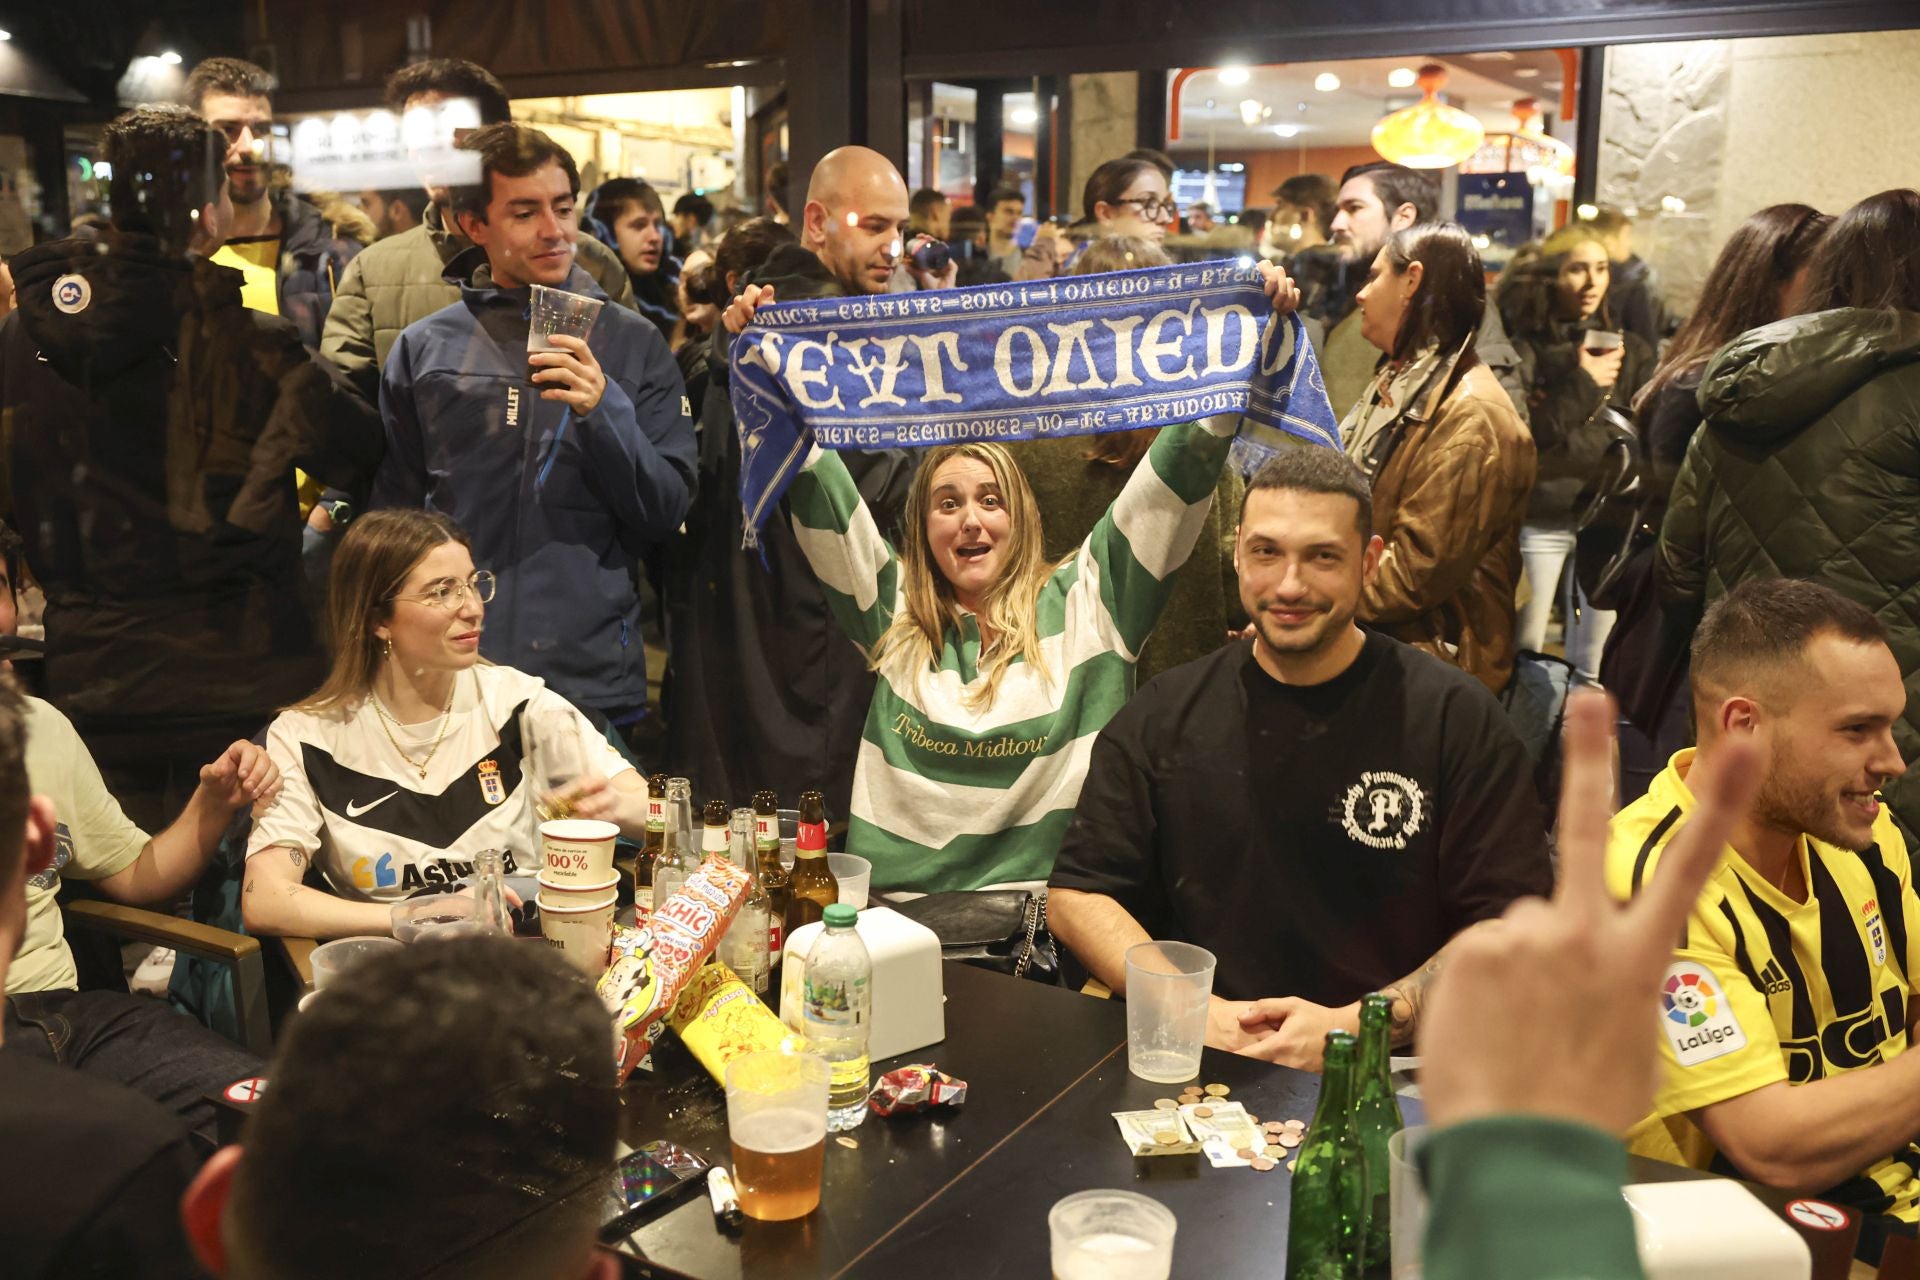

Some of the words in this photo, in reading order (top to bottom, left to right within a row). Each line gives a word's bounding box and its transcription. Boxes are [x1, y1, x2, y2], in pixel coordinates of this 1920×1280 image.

[506, 386, 520, 427] MILLET
[891, 712, 959, 756] Tribeca
[1677, 1024, 1736, 1053] LaLiga
